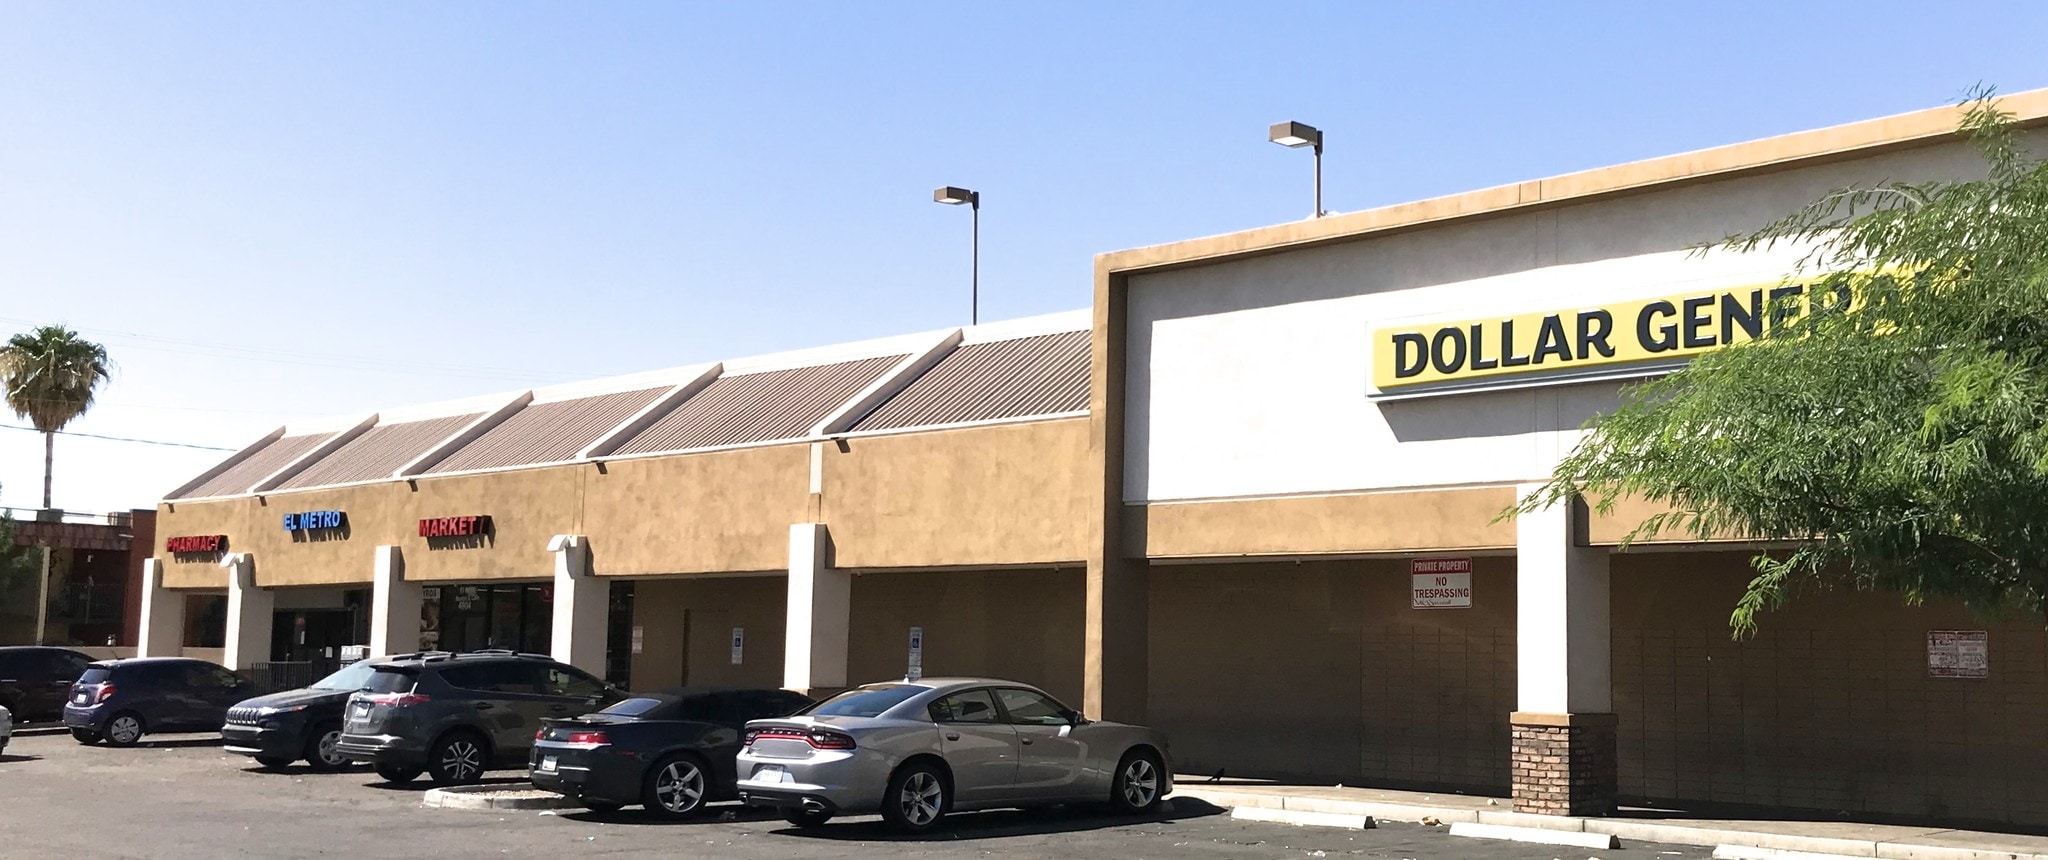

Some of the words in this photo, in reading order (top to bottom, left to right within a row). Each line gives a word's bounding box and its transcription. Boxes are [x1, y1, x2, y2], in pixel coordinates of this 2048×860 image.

[1392, 309, 1616, 379] DOLLAR
[284, 513, 297, 530] EL
[300, 511, 341, 529] METRO
[167, 535, 220, 552] PHARMACY
[1414, 562, 1437, 572] PRIVATE
[1438, 561, 1469, 571] PROPERTY
[1435, 576, 1447, 586] NO
[1414, 588, 1469, 599] TRESPASSING
